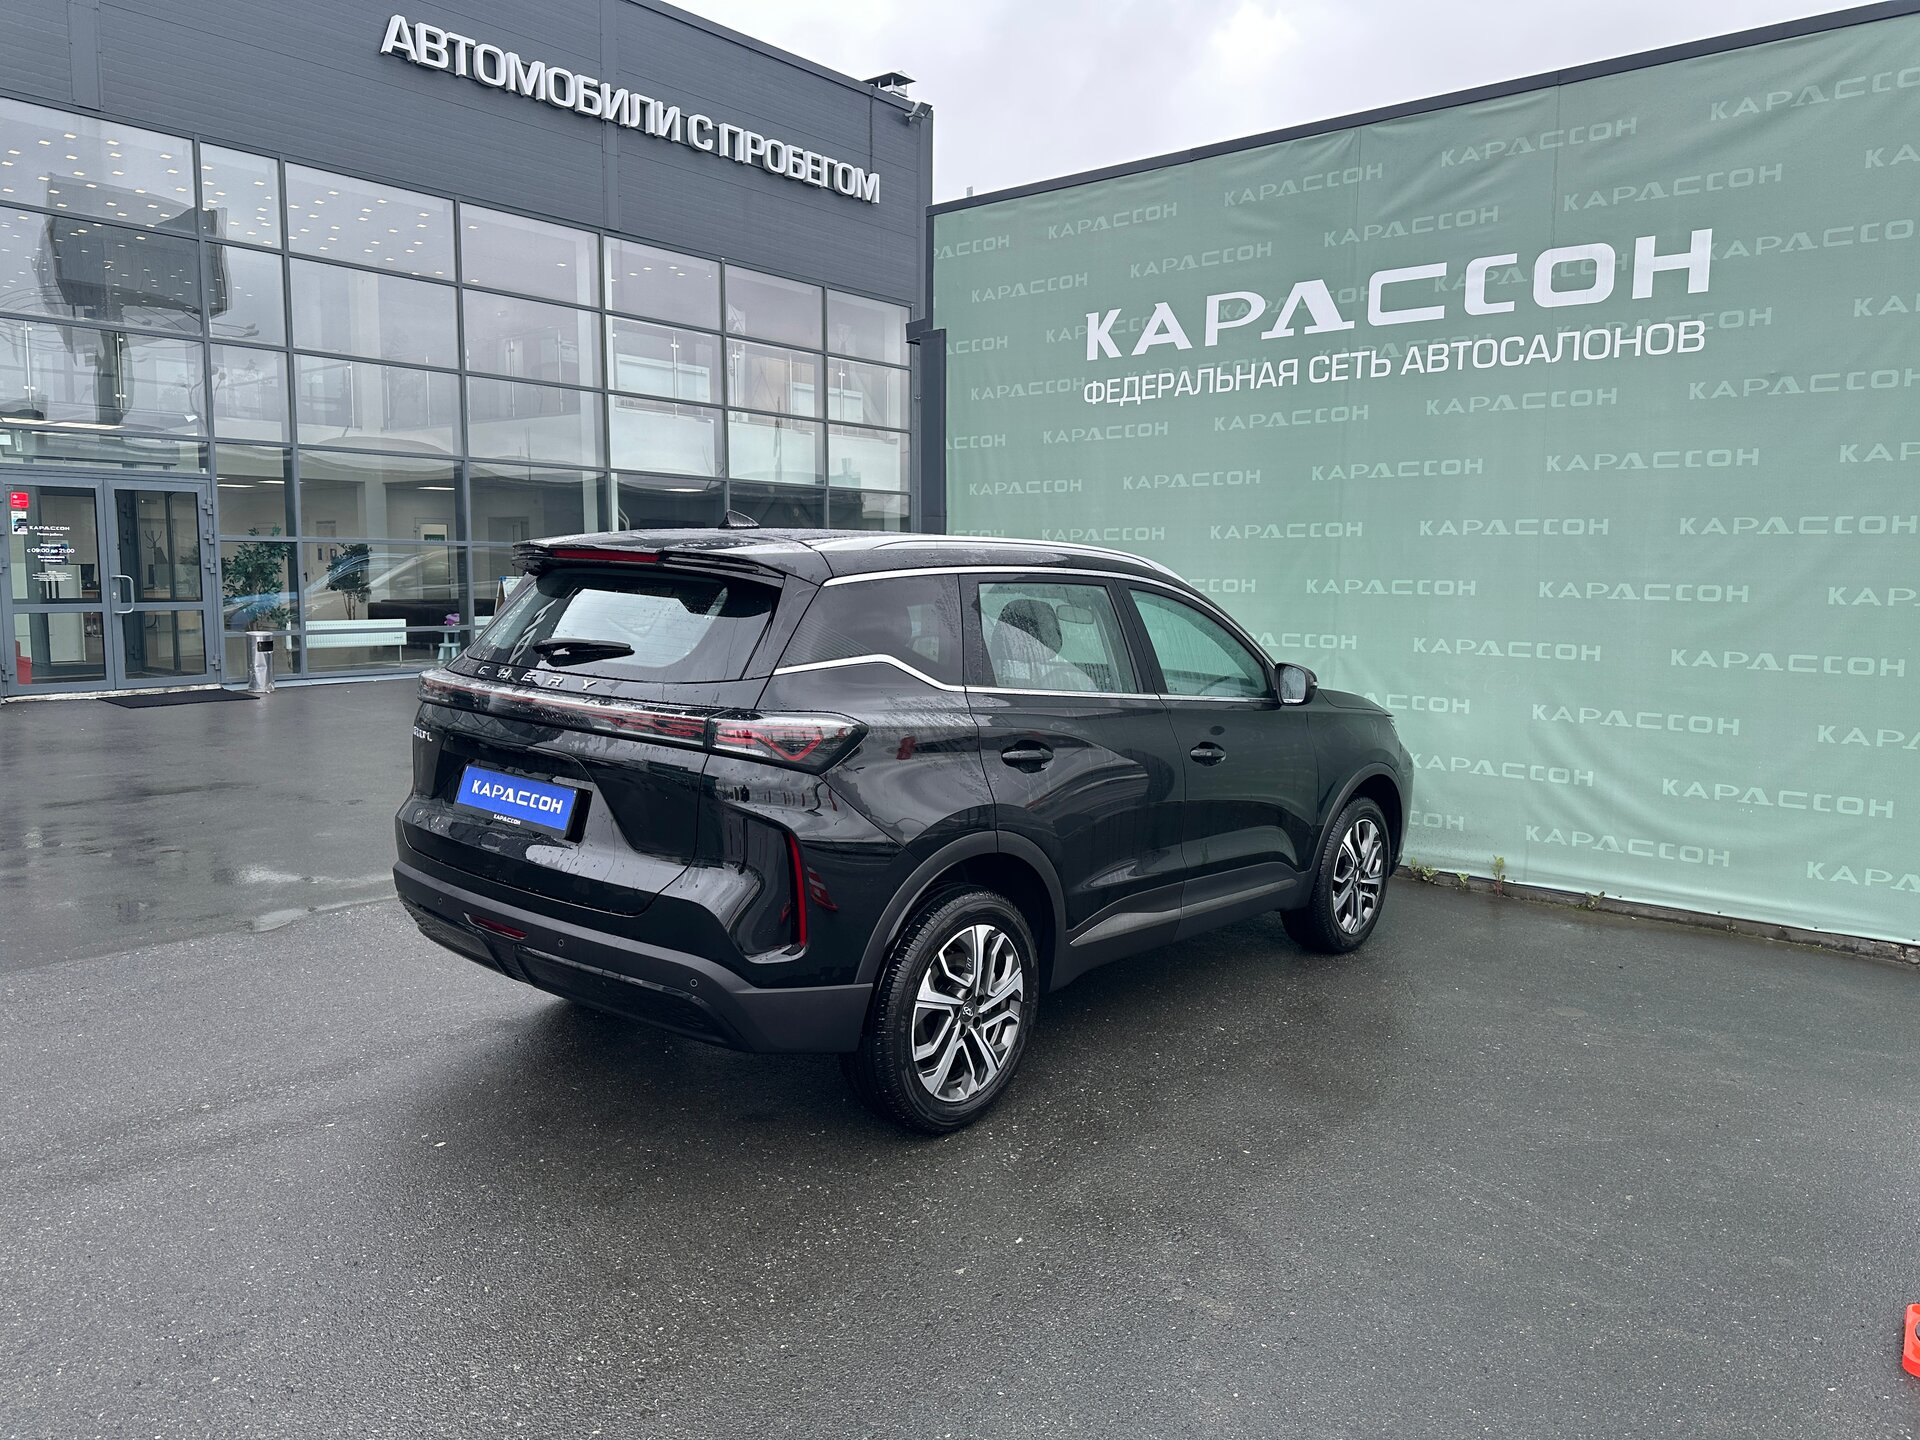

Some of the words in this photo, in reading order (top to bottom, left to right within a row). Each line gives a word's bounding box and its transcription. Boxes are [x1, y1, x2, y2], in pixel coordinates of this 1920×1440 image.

[1710, 65, 1920, 121] КАРАССО
[380, 14, 680, 141] АВТОМОБИЛИ
[688, 114, 713, 151] С
[719, 122, 880, 205] ПРОБЕГОМ
[1440, 117, 1637, 168] КАРАССОН
[1224, 163, 1383, 207] КАРАССОН
[1563, 163, 1783, 212] КАРАССОН
[1048, 202, 1178, 240] КАРАССОН
[1324, 205, 1499, 248] КАРАССОН
[1130, 241, 1273, 279] КАРАССОН
[972, 272, 1088, 303] КАРАССОН
[1086, 228, 1712, 361] КАРАССОН
[1084, 359, 1298, 406] ФЕДЕРАЛЬНАЯ
[1308, 350, 1392, 383] СЕТЬ
[1400, 320, 1706, 375] АВТОСАЛОНОВ
[1426, 387, 1617, 415] КАРАССОН
[1214, 404, 1369, 431] КАРАССОН
[1043, 421, 1169, 444] КАРАССОН
[1312, 458, 1483, 481] КАРАССОН
[1546, 447, 1759, 472] КАРАССОН
[969, 479, 1082, 496] КАРАССОН
[1123, 469, 1261, 491] КАРАССОН
[1041, 527, 1166, 542] КАРАССОН
[1210, 521, 1363, 540] КАРАССОН
[1419, 517, 1609, 537] КАРАССОН
[1680, 515, 1918, 535] КАРАССОН
[1305, 578, 1477, 596] КАРАССОН
[1539, 581, 1749, 603] КАРАССОН
[1413, 637, 1601, 662] КАРАССОН
[1670, 648, 1906, 677] КАРАССОН
[477, 665, 597, 690] CHERY
[1532, 703, 1740, 736] КАРАССОН
[471, 779, 564, 814] КАРАССОН
[1662, 778, 1894, 819] КАРАССОН
[493, 813, 521, 825] КАРАССОН
[1526, 825, 1730, 867] КАРАССОН
